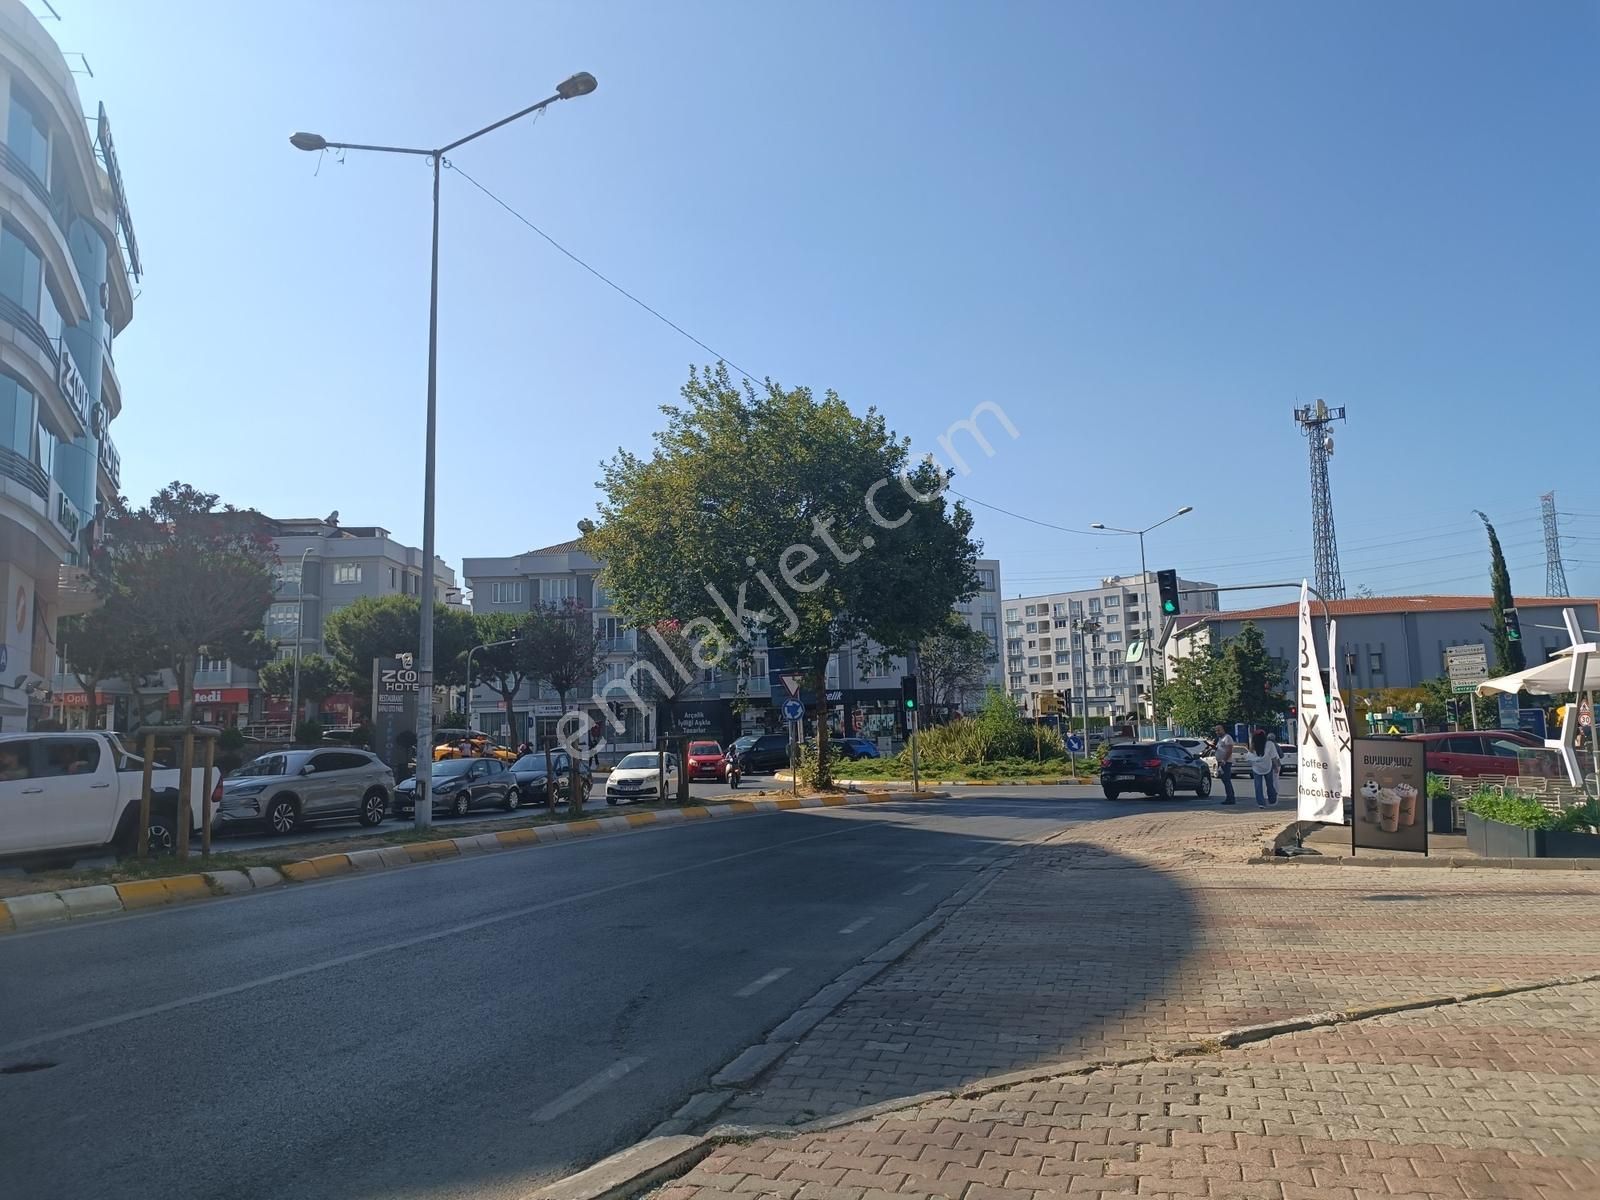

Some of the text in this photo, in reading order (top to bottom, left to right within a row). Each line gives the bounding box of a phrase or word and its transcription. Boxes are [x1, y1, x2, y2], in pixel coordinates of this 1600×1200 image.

[382, 669, 419, 682] ZOO
[386, 683, 420, 691] HOTE
[684, 711, 705, 719] Arçelik
[1301, 756, 1329, 770] Coffee
[1311, 772, 1318, 783] &
[1299, 784, 1342, 799] Chocolate
